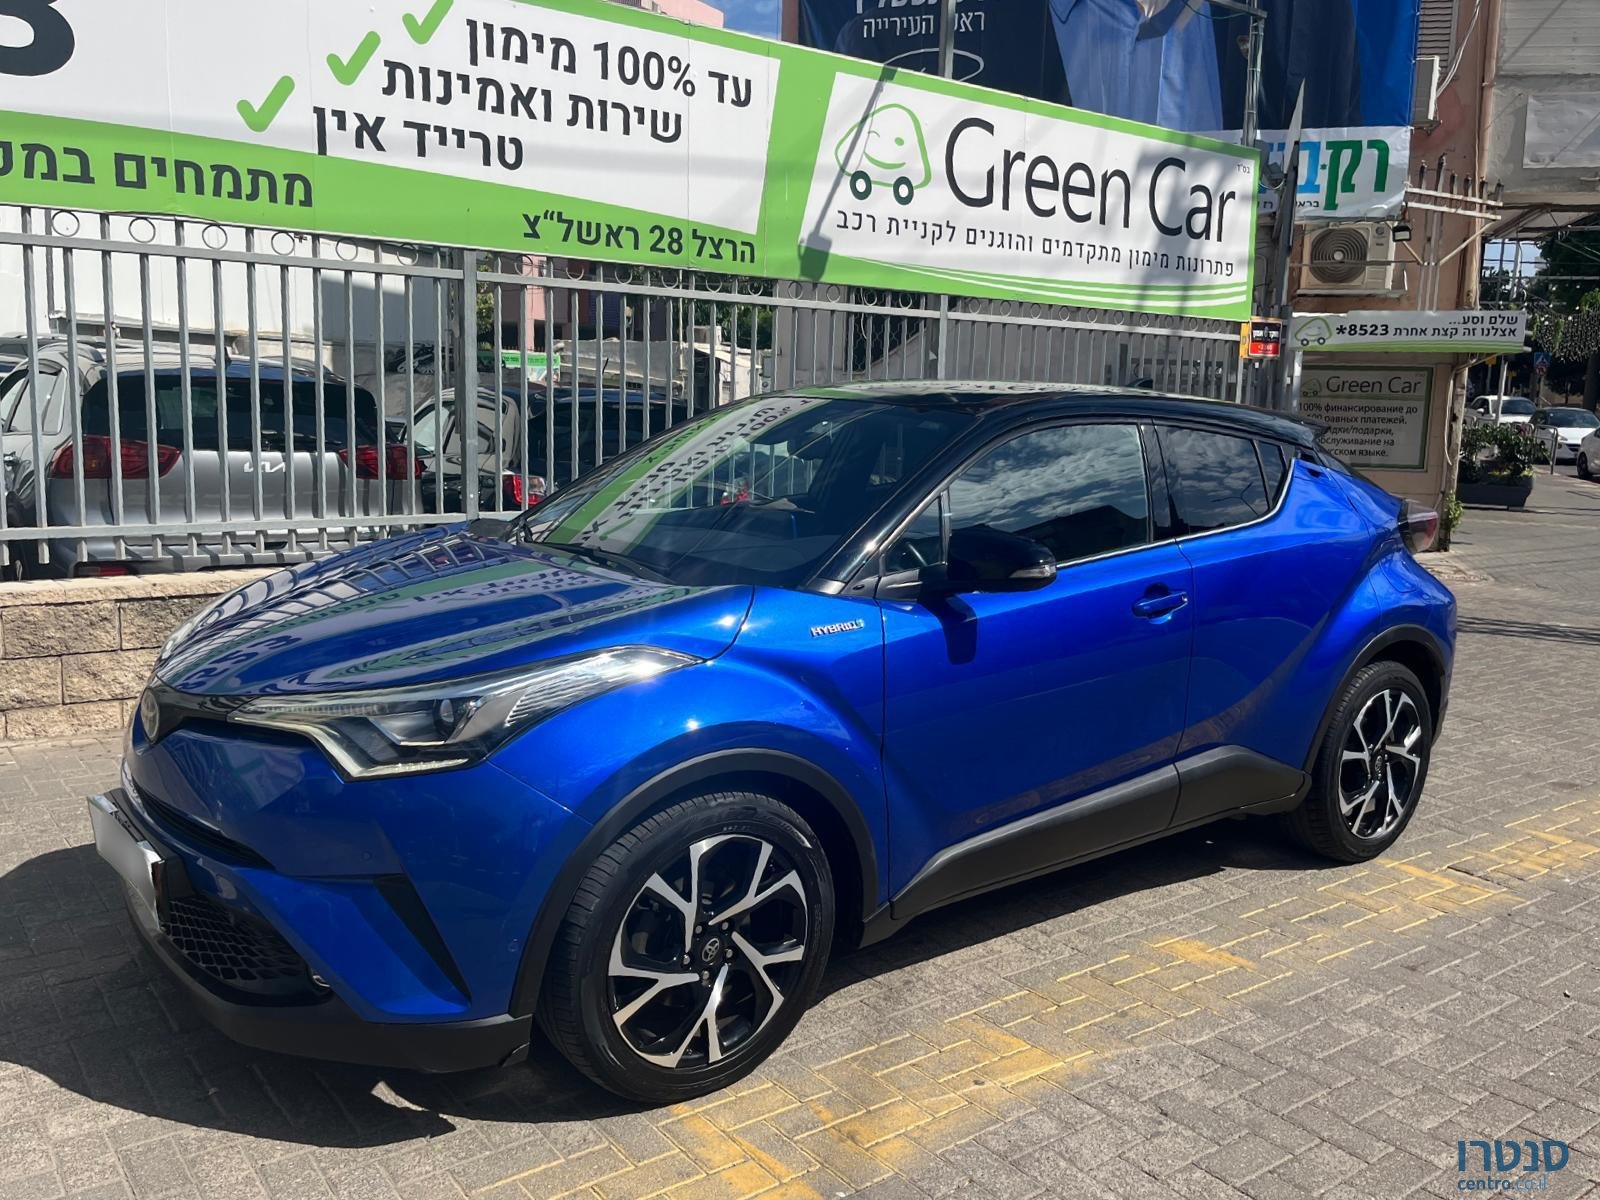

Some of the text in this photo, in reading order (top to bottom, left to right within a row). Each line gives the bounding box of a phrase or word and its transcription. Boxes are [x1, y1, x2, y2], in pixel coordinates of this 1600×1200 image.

[863, 14, 934, 38] העירייה
[465, 18, 752, 108] עד 100% מימון
[382, 59, 682, 144] שירות ואמינות
[312, 105, 524, 171] טרייד אין
[114, 152, 313, 208] מתמחים
[945, 117, 1130, 229] Green
[1148, 157, 1236, 242] Car
[1323, 139, 1390, 211] רק
[649, 224, 684, 255] 28
[692, 229, 755, 264] הרצל
[836, 210, 1234, 277] פתרונות מימון מתקדמים והוגנים לקניית רכב
[1480, 326, 1517, 337] אצלנו
[1489, 314, 1518, 325] שלם
[1393, 327, 1427, 337] אחרת
[1431, 326, 1458, 339] קצת
[1462, 327, 1476, 337] זה
[1326, 376, 1421, 394] Green Car
[1299, 402, 1418, 414] 100% финансирование до
[1383, 438, 1395, 447] на
[810, 620, 858, 637] HYBRID
